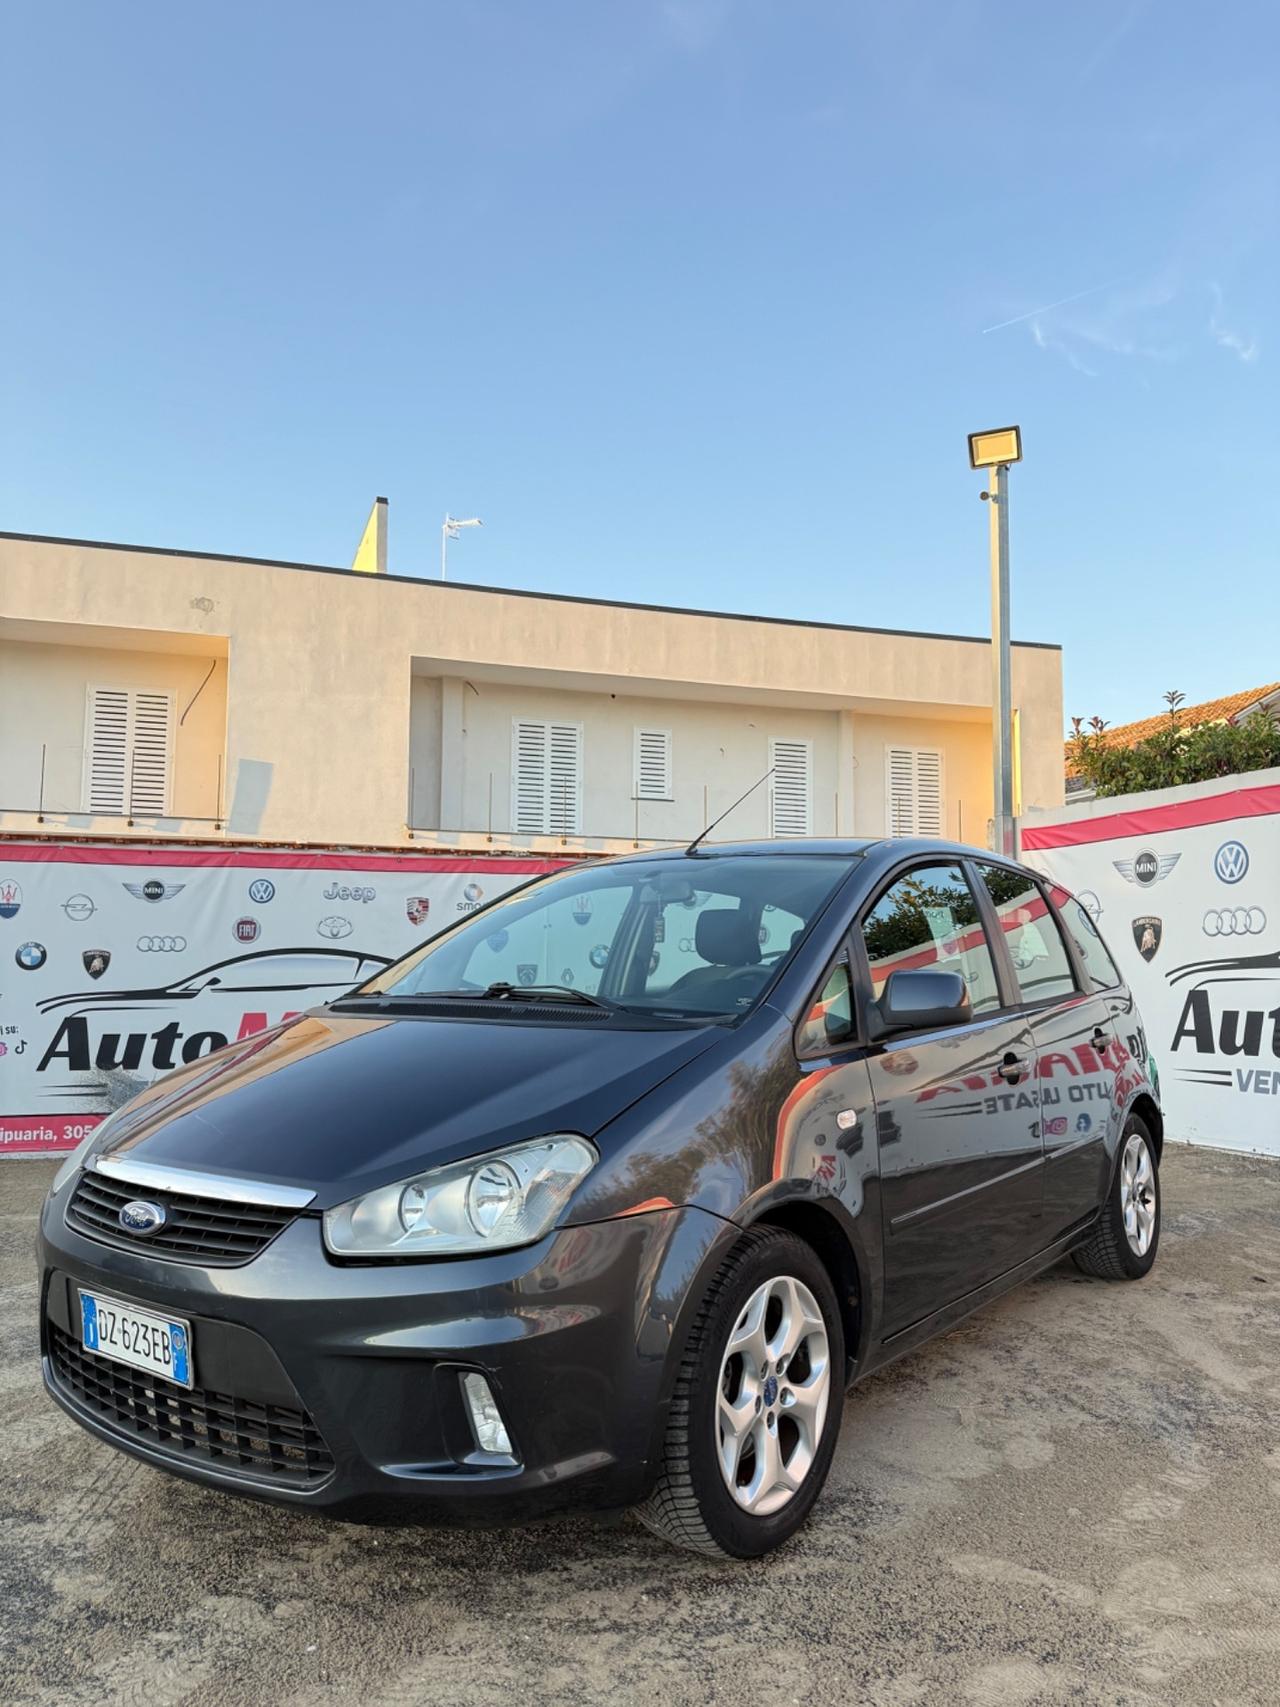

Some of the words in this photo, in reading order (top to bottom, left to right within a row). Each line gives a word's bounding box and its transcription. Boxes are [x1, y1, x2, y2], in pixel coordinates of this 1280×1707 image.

[1136, 861, 1157, 874] MINI
[144, 886, 164, 894] MINI
[323, 882, 376, 903] Jeep
[238, 924, 256, 937] FIAT
[0, 1127, 58, 1144] ipuaria,
[98, 1309, 118, 1345] DZ
[121, 1318, 172, 1365] 623EB
